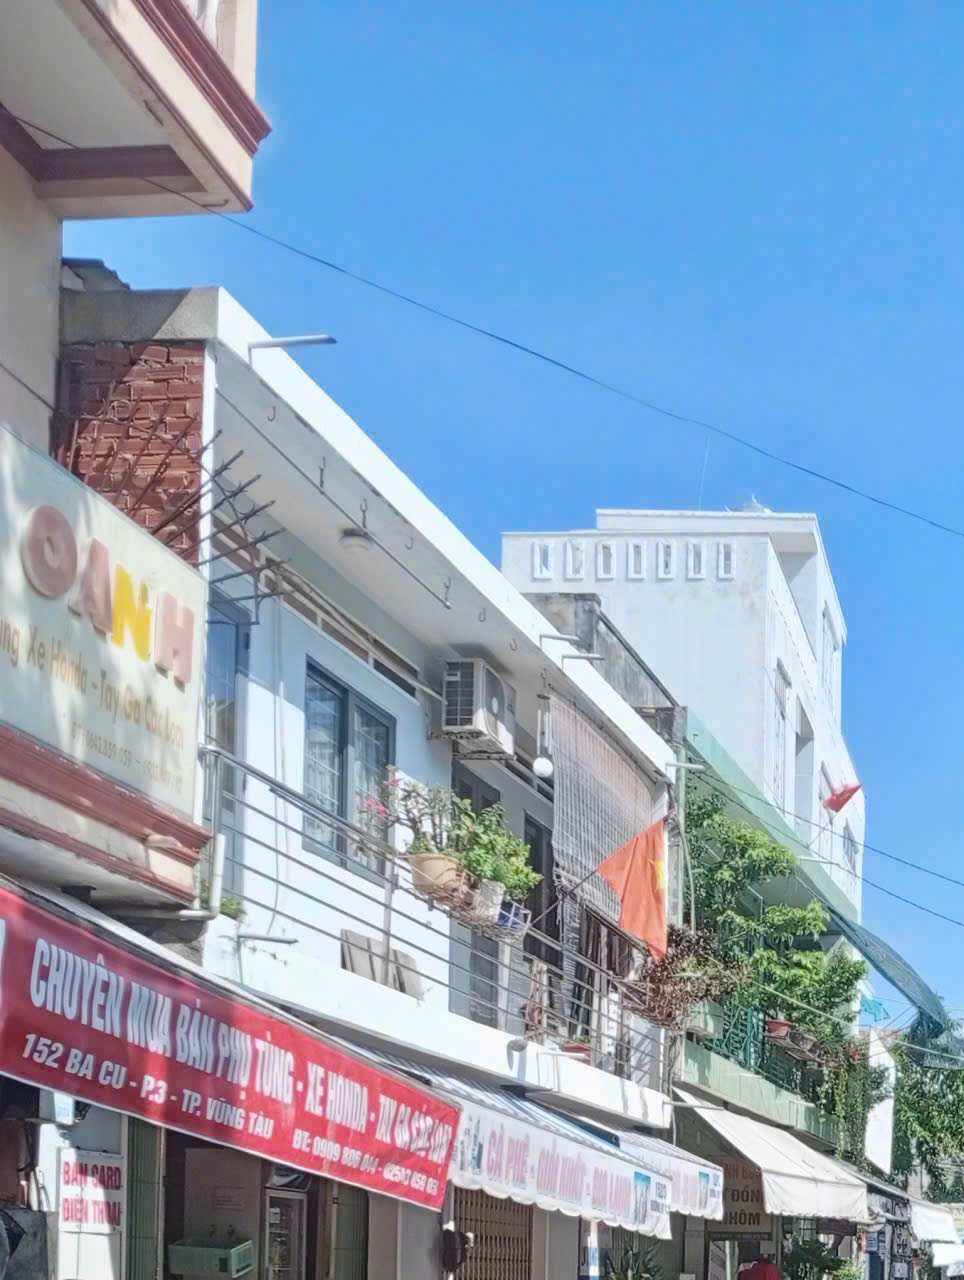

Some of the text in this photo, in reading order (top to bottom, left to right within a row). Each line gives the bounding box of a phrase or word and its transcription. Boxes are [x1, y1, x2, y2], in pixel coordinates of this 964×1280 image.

[20, 504, 194, 690] OANH
[22, 1033, 64, 1069] 152
[65, 1047, 95, 1080] BA
[98, 1060, 128, 1090] CU
[140, 1075, 168, 1105] P.3
[181, 1089, 202, 1117] TP.
[205, 1097, 246, 1131] VŨNG
[248, 1111, 275, 1140] TÀU
[312, 1136, 341, 1162] 0909
[30, 938, 125, 1038] CHUYÊN
[127, 982, 172, 1058] MUA
[216, 1021, 252, 1100] PHỤ
[254, 1031, 295, 1105] TÙNG
[305, 1061, 324, 1116] XE
[326, 1070, 369, 1134] HONDA
[376, 1093, 398, 1145] TAY
